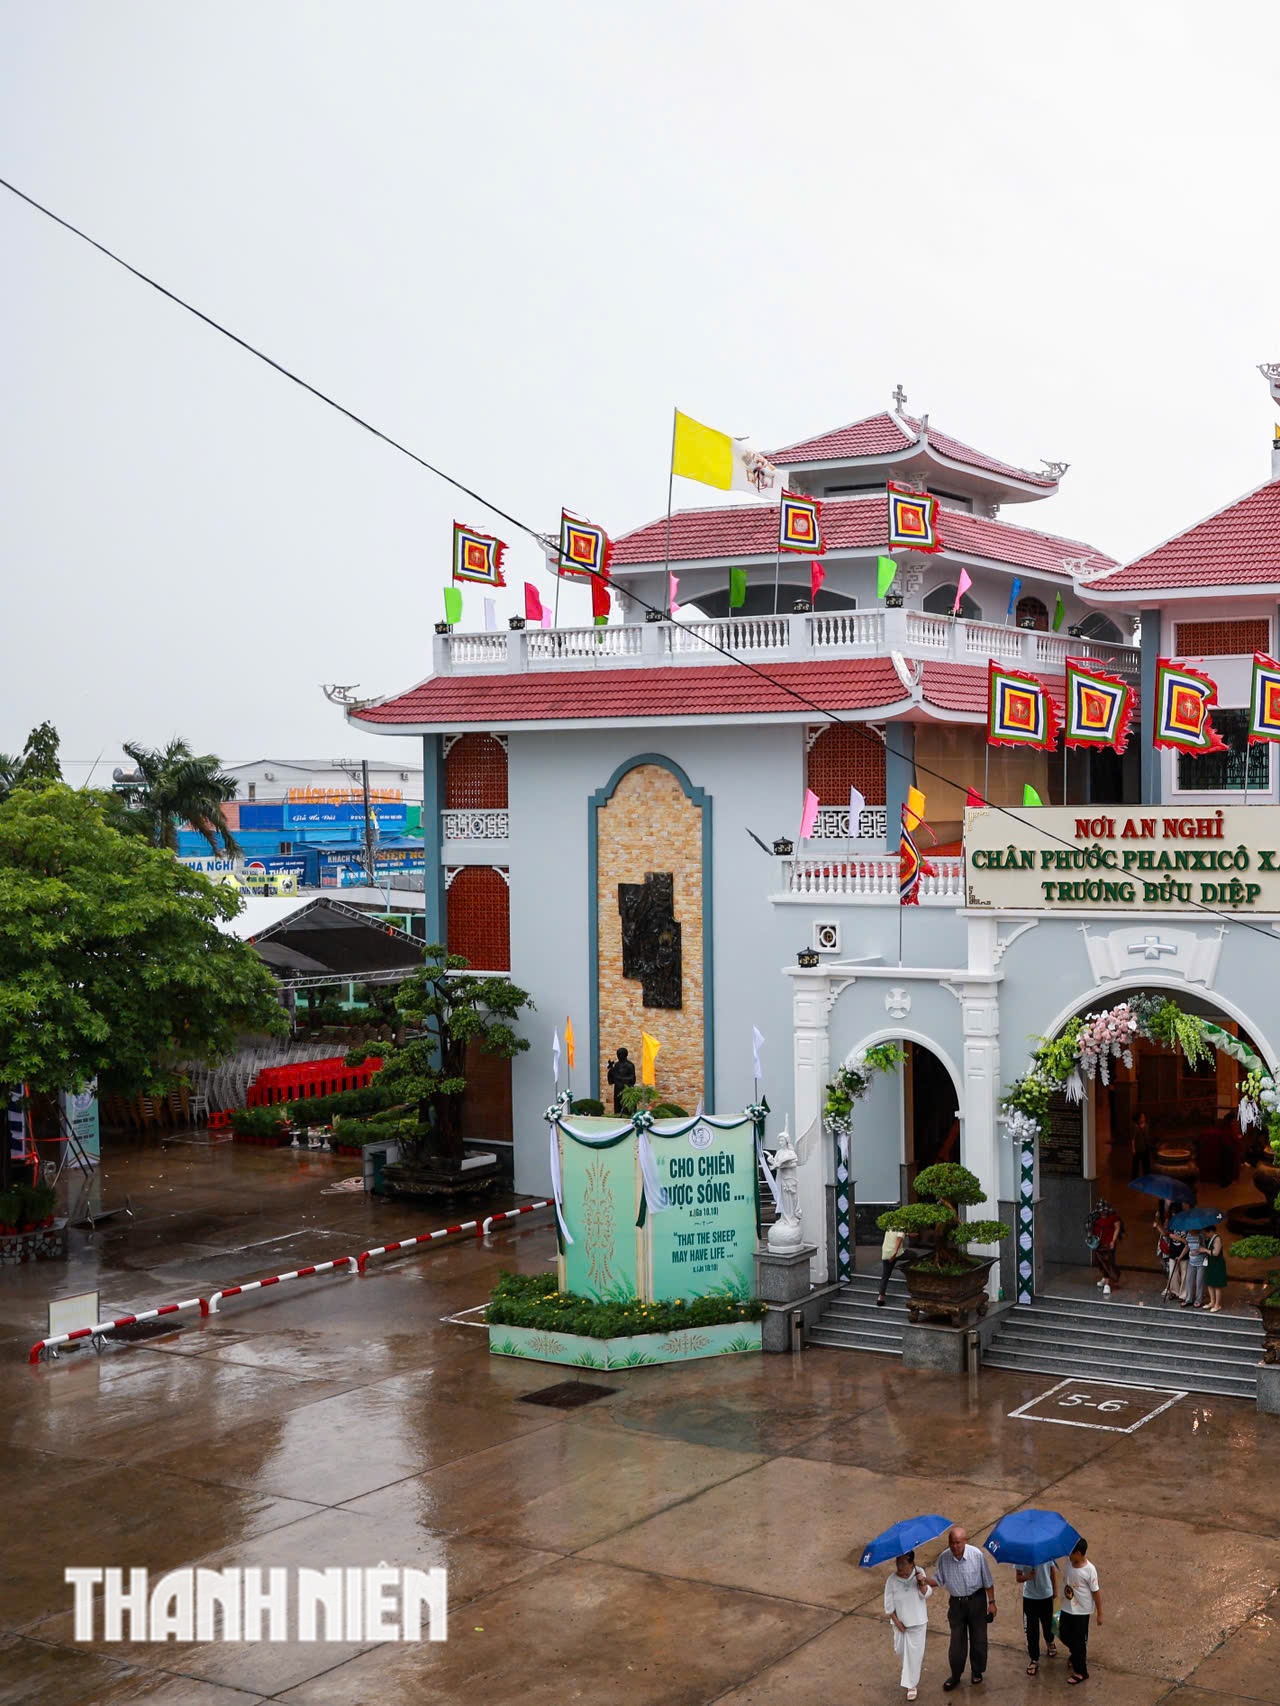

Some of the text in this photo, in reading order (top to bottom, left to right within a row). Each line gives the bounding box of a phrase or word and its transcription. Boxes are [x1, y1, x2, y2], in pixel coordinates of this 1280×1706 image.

[1074, 810, 1225, 839] NƠI AN NGHỈ
[971, 845, 1035, 870] CHÂN
[1041, 843, 1118, 871] PHƯỚC
[1122, 844, 1250, 872] PHANXICÔ
[1041, 874, 1261, 909] TRƯƠNG BỬU DIỆP
[670, 1151, 734, 1178] CHO CHIÊN
[697, 1176, 730, 1204] SỐNG
[697, 1232, 710, 1245] THE
[712, 1230, 736, 1243] SHEEP
[672, 1250, 688, 1263] MAY
[690, 1248, 708, 1261] HAVE
[710, 1247, 725, 1260] LIFE
[1058, 1393, 1129, 1412] 5-6
